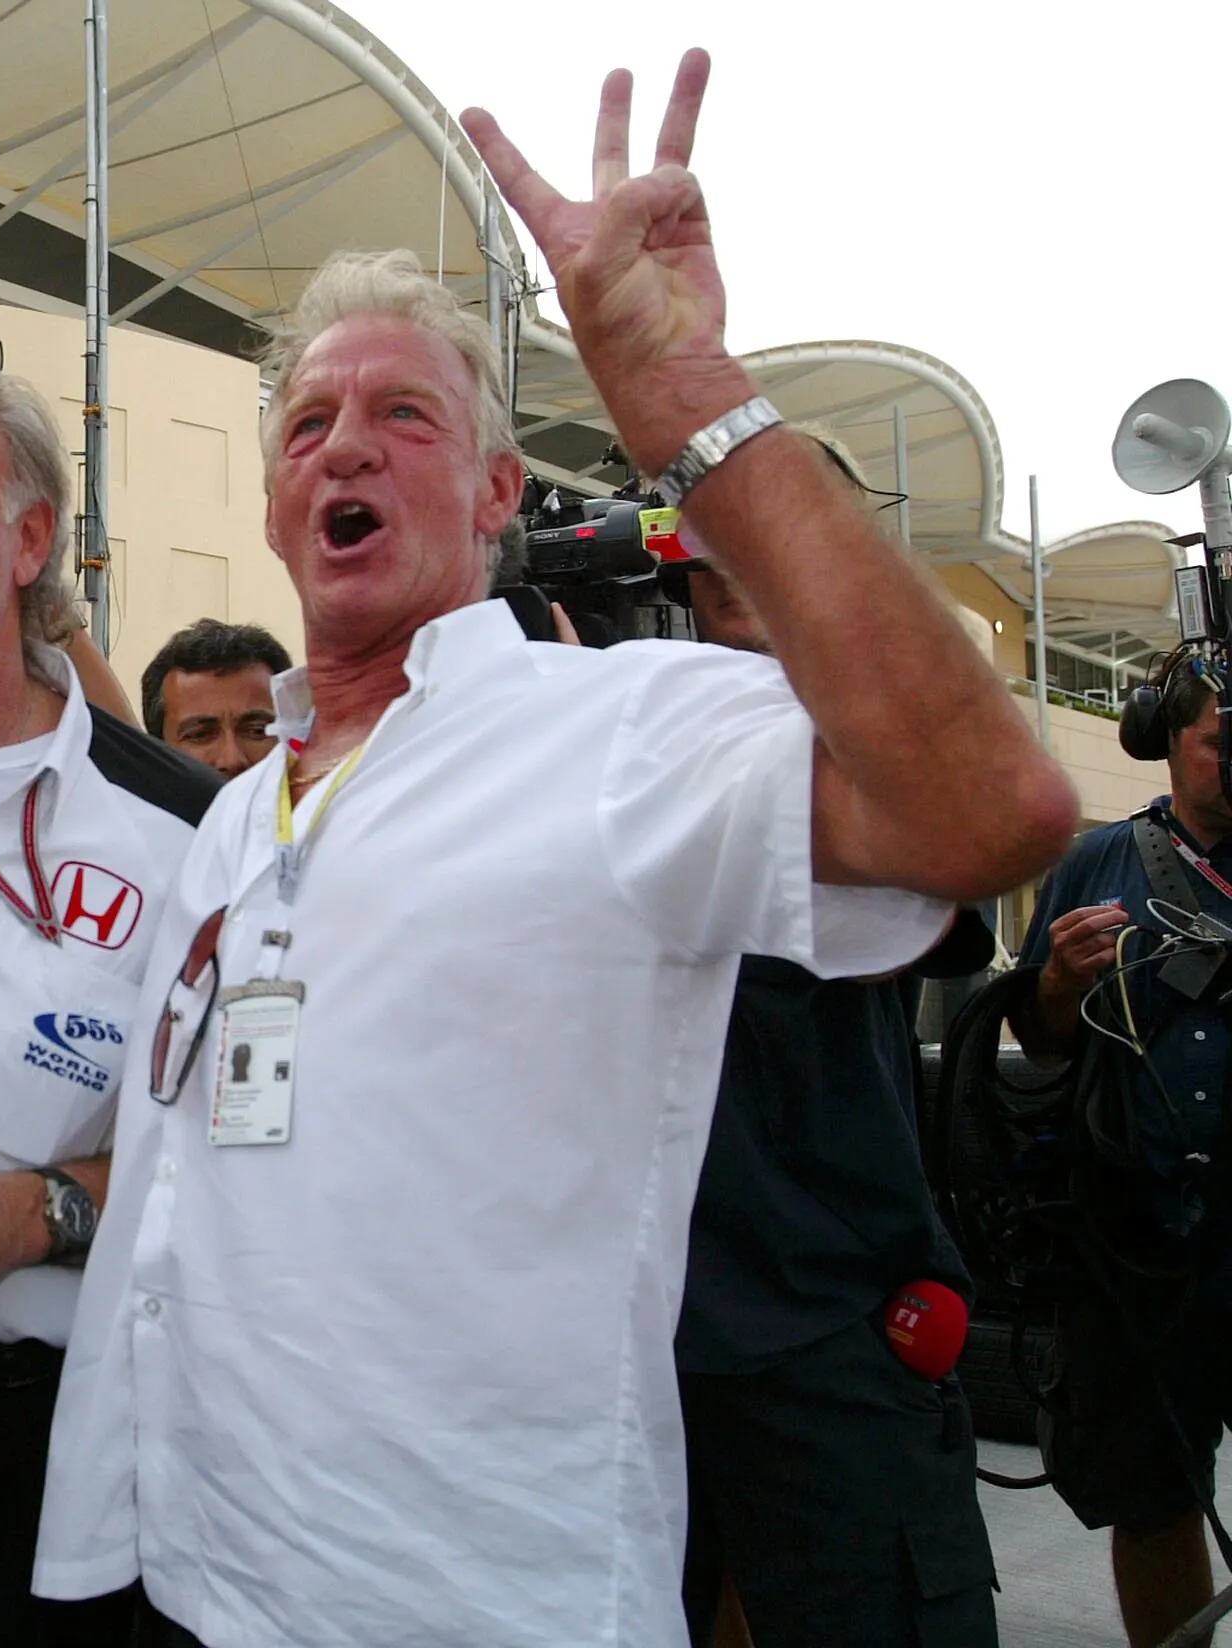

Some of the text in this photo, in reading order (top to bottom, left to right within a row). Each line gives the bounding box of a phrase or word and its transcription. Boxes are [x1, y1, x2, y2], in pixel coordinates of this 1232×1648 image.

[65, 1013, 123, 1045] 555
[23, 1053, 105, 1092] RACING
[28, 1042, 109, 1082] WORLD
